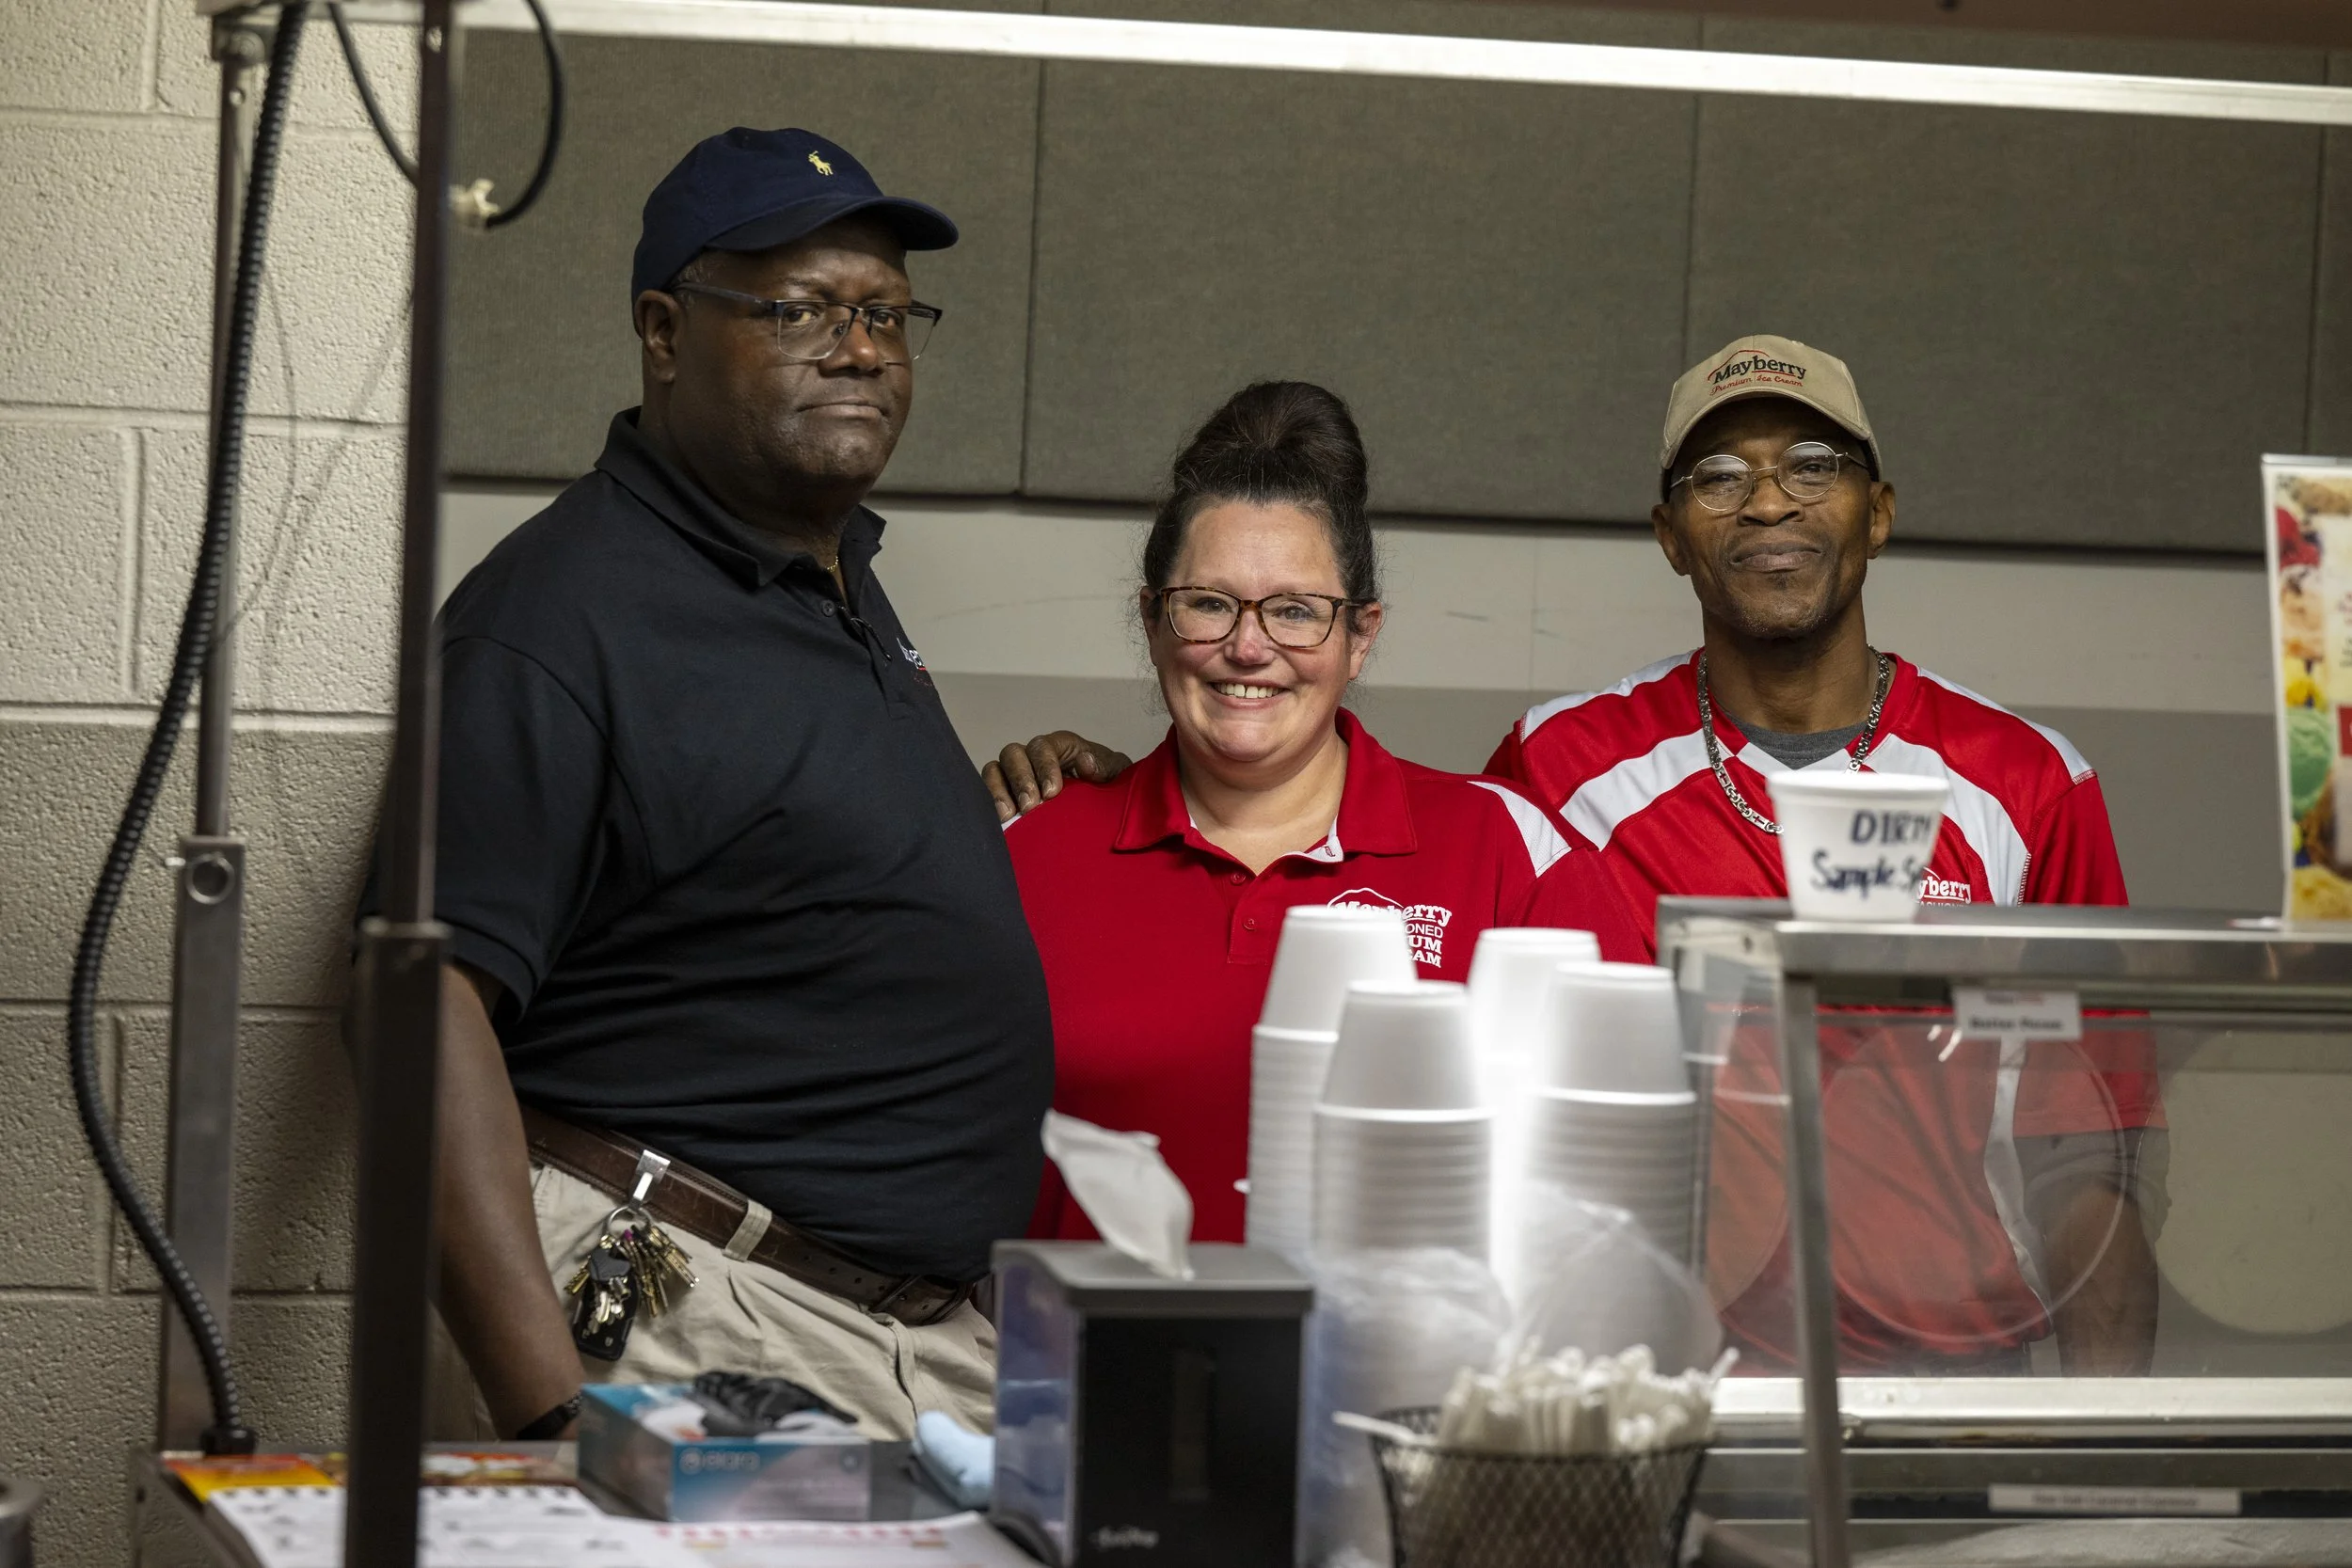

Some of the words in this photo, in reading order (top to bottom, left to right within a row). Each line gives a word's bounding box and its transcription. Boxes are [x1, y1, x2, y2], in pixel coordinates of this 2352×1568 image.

[1713, 355, 1806, 385] Mayberry
[1709, 377, 1752, 396] Premium
[1774, 375, 1803, 388] Cream
